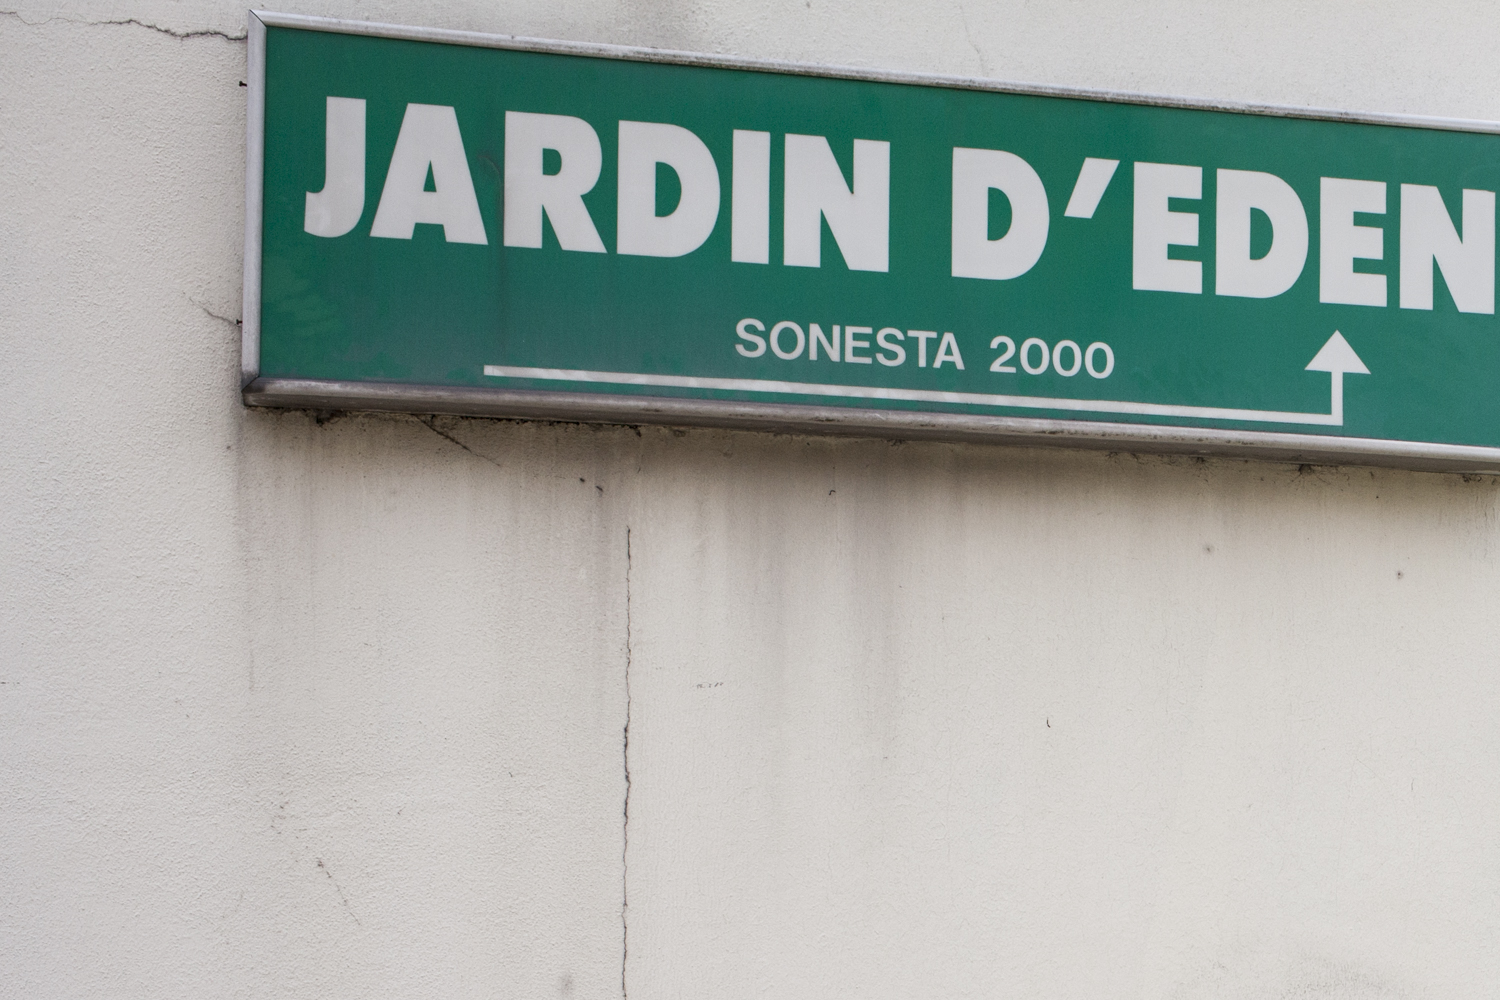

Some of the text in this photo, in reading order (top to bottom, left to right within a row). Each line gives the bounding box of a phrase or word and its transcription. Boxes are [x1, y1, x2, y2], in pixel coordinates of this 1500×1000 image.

[304, 96, 1496, 315] JARDIN D'EDEN
[735, 318, 1115, 379] SONESTA 2000
